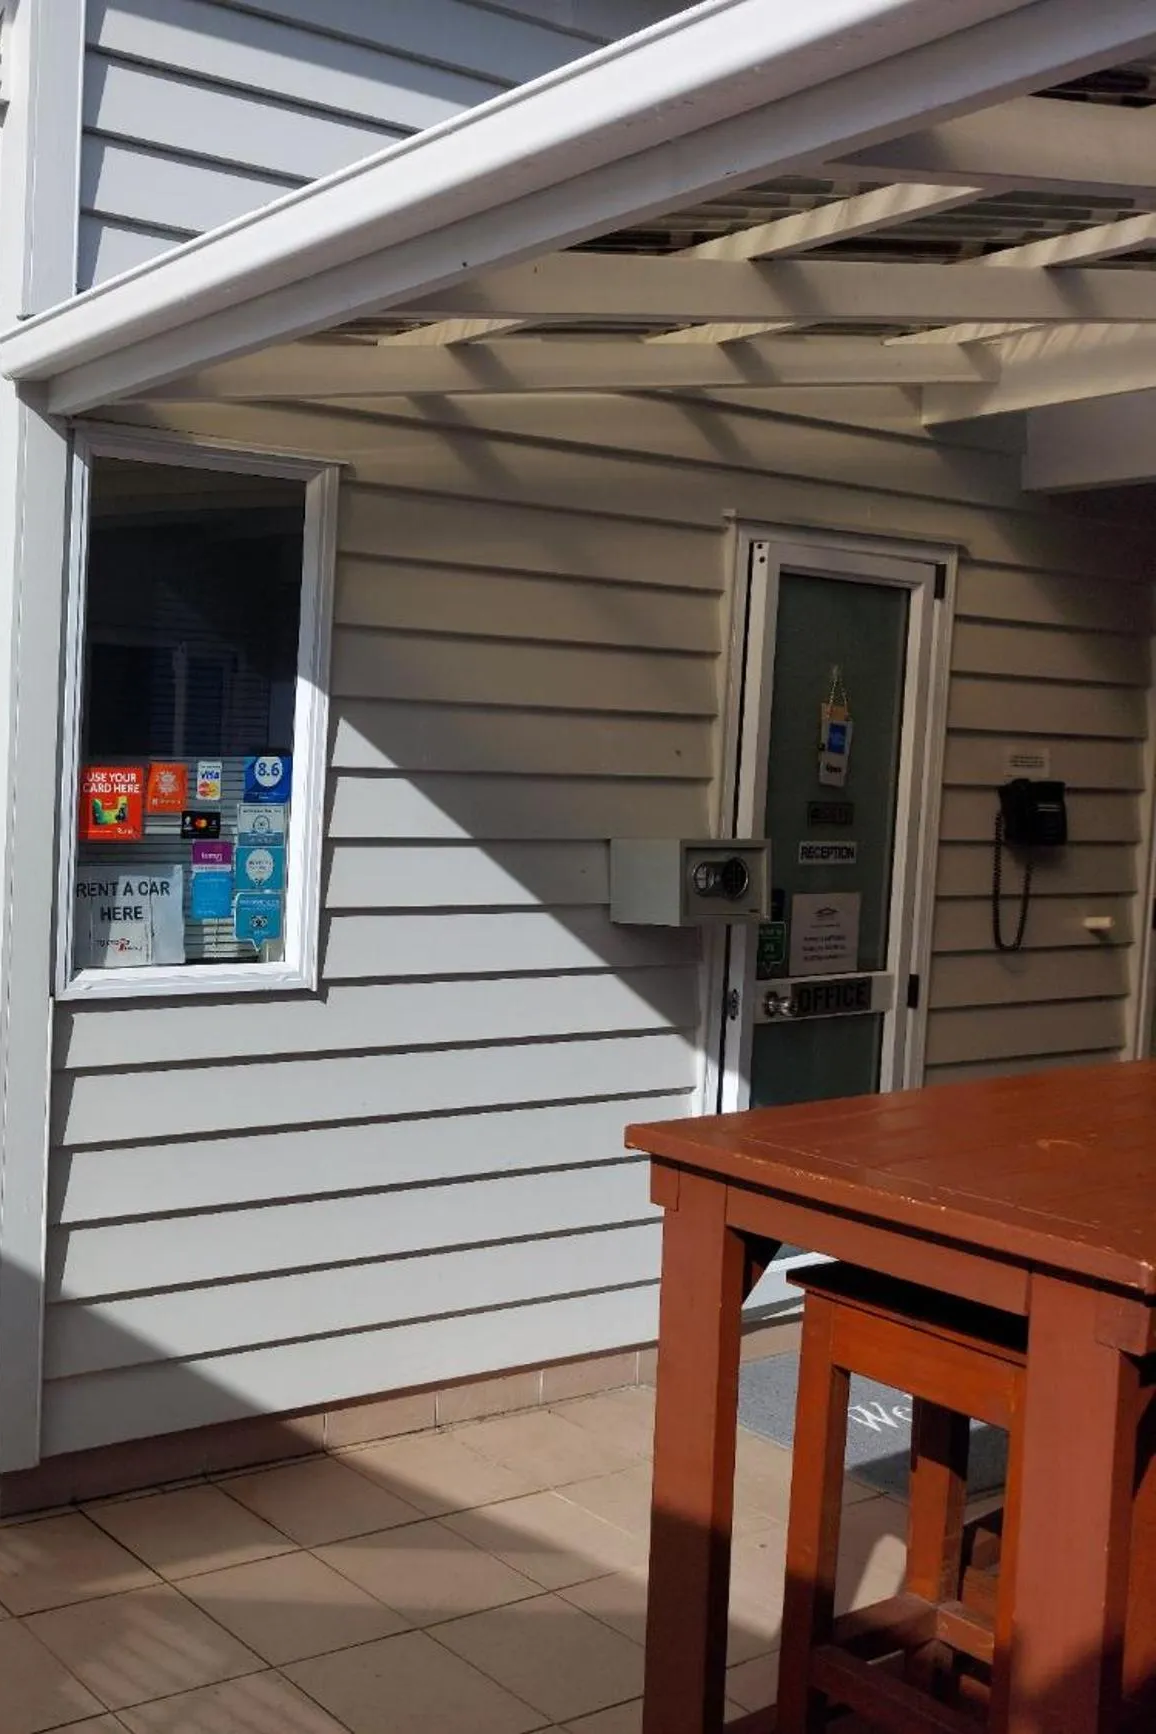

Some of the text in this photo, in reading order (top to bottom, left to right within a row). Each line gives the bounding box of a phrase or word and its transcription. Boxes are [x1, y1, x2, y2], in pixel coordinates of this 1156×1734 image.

[258, 762, 280, 777] 8.6
[87, 772, 137, 783] USE YOUR
[83, 783, 140, 793] CARD HERE
[800, 845, 855, 860] RECEPTION
[76, 881, 170, 898] RENT A CAR
[100, 905, 144, 921] HERE
[798, 981, 867, 1012] OFFICE
[848, 1394, 912, 1431] We
